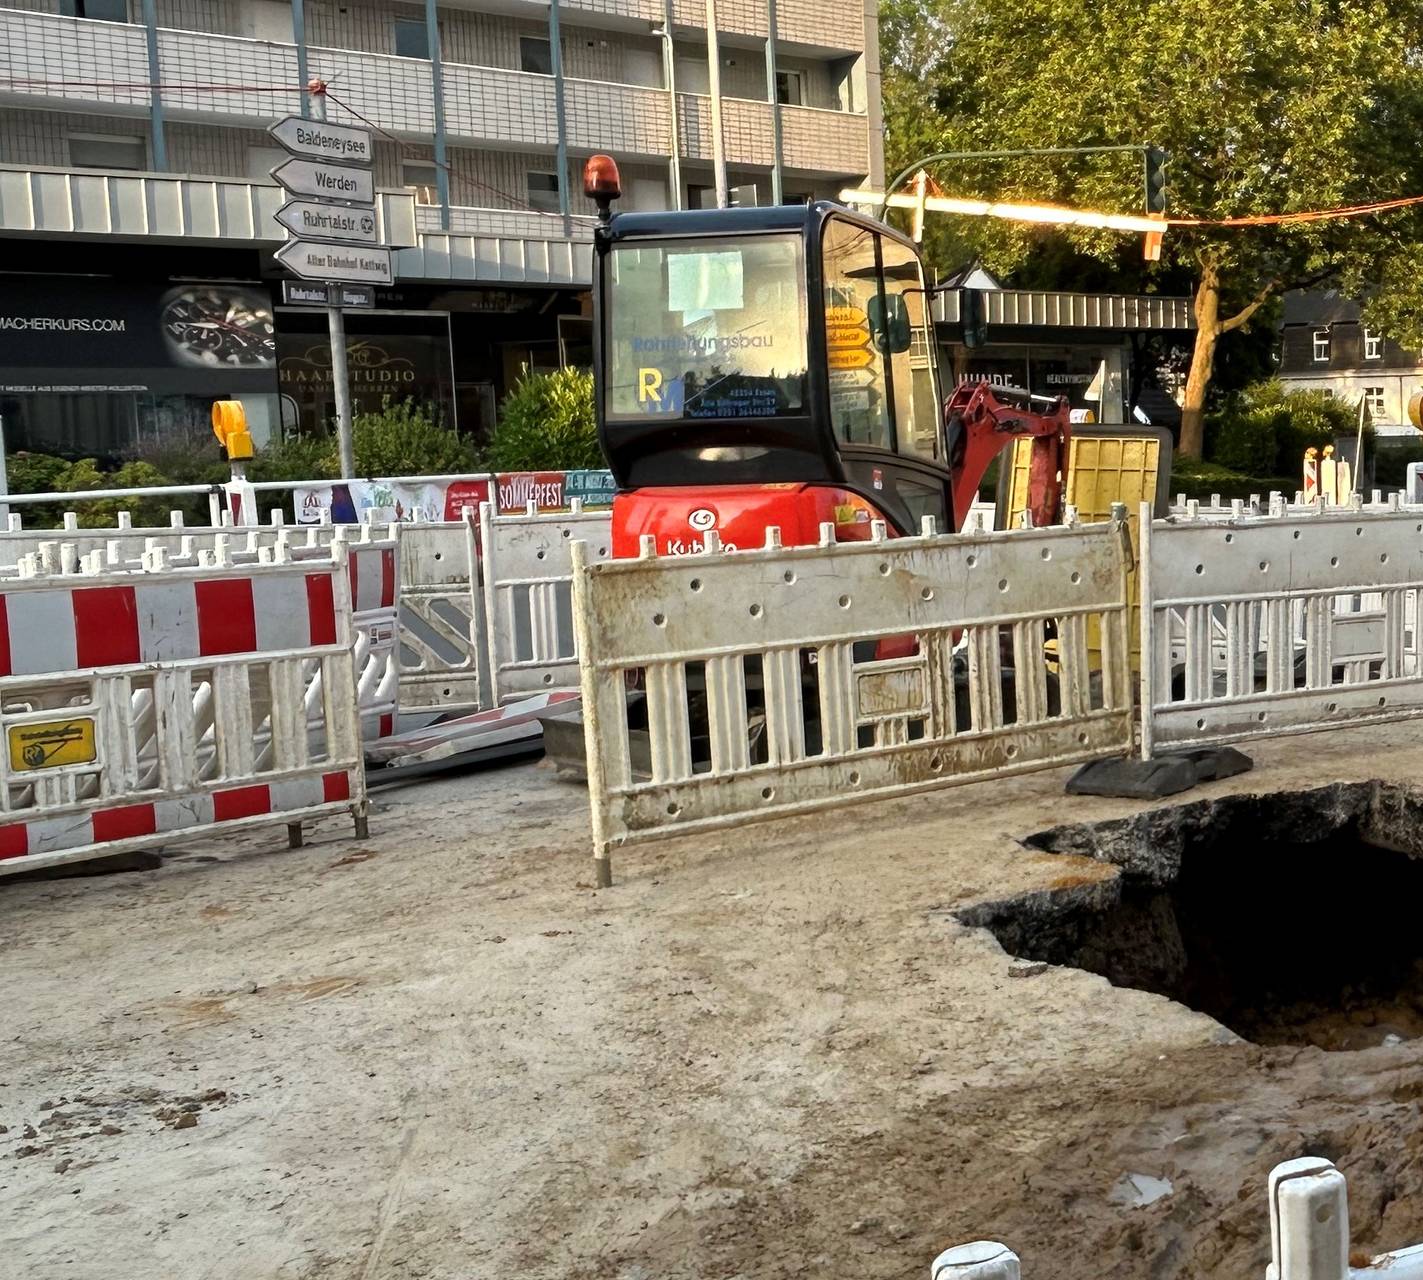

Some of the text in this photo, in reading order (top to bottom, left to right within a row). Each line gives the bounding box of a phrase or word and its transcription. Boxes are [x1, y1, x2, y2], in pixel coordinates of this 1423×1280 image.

[296, 127, 366, 154] Baldeneysee
[314, 170, 357, 192] Werden
[303, 210, 359, 232] Ruhrtalstr.
[307, 253, 388, 275] Alter Bahnhof Kettwig
[499, 482, 562, 509] SOMMERFEST
